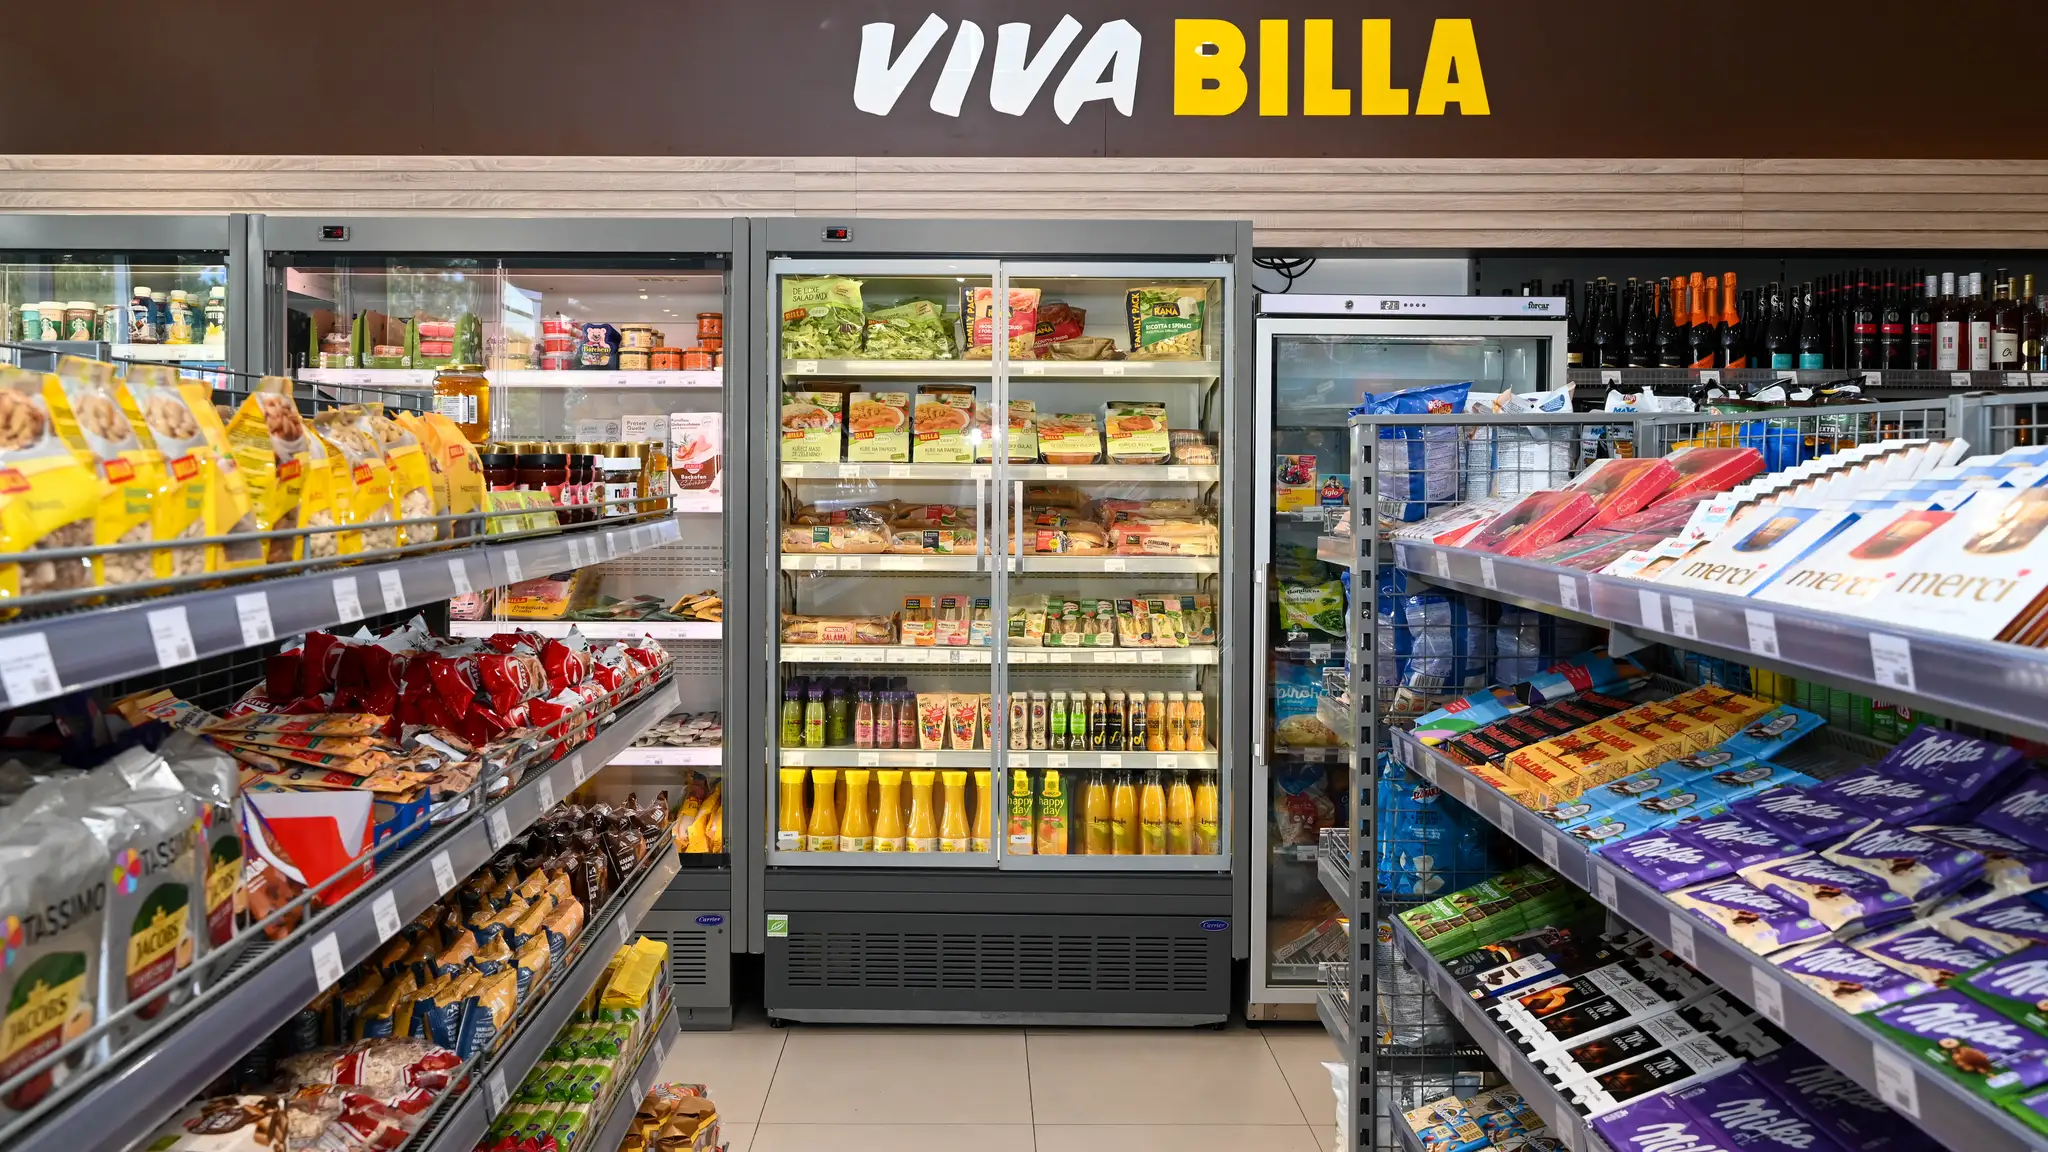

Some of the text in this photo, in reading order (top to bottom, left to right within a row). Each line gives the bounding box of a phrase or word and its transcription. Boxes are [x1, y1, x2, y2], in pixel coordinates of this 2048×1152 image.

[854, 12, 1491, 124] VIVA BILLA
[965, 290, 974, 347] FAMILY PACK
[1131, 293, 1142, 348] FAMILY PACK
[1154, 307, 1178, 316] RANA
[1036, 326, 1054, 335] ANA
[855, 432, 874, 440] BILLA
[920, 432, 939, 440] BILLA
[614, 487, 630, 498] nute
[1682, 561, 1766, 586] merci
[1786, 570, 1894, 597] merci
[1896, 569, 2029, 603] merci
[1276, 686, 1322, 705] piroh
[1900, 736, 1987, 770] Milka
[1511, 751, 1557, 783] TOBLERONE
[1833, 775, 1925, 798] Milka
[1008, 796, 1034, 809] happy
[1012, 806, 1029, 816] day
[1039, 796, 1065, 809] happy
[1043, 806, 1060, 816] day
[1756, 793, 1844, 820] Milka
[1693, 821, 1781, 847] Milka
[1850, 830, 1935, 855] Milka
[1623, 837, 1705, 864] Milka
[1779, 858, 1864, 885] Milka
[1702, 883, 1783, 912] Milka
[22, 882, 108, 946] TASSIMO
[697, 916, 723, 924] Carrier
[136, 923, 181, 966] JACOBS
[1888, 936, 1988, 969] Milka
[1794, 947, 1888, 979] Milka
[9, 992, 69, 1043] JACOBS
[1585, 1007, 1600, 1020] COCOA
[1593, 1001, 1619, 1017] 70%
[1897, 1003, 2024, 1049] Milka
[1612, 1036, 1629, 1051] COCOA
[1621, 1030, 1648, 1048] 70%
[1691, 1038, 1719, 1056] Lindt
[1643, 1062, 1662, 1079] COCOA
[1652, 1056, 1681, 1075] 70%
[1710, 1098, 1816, 1149] Milka
